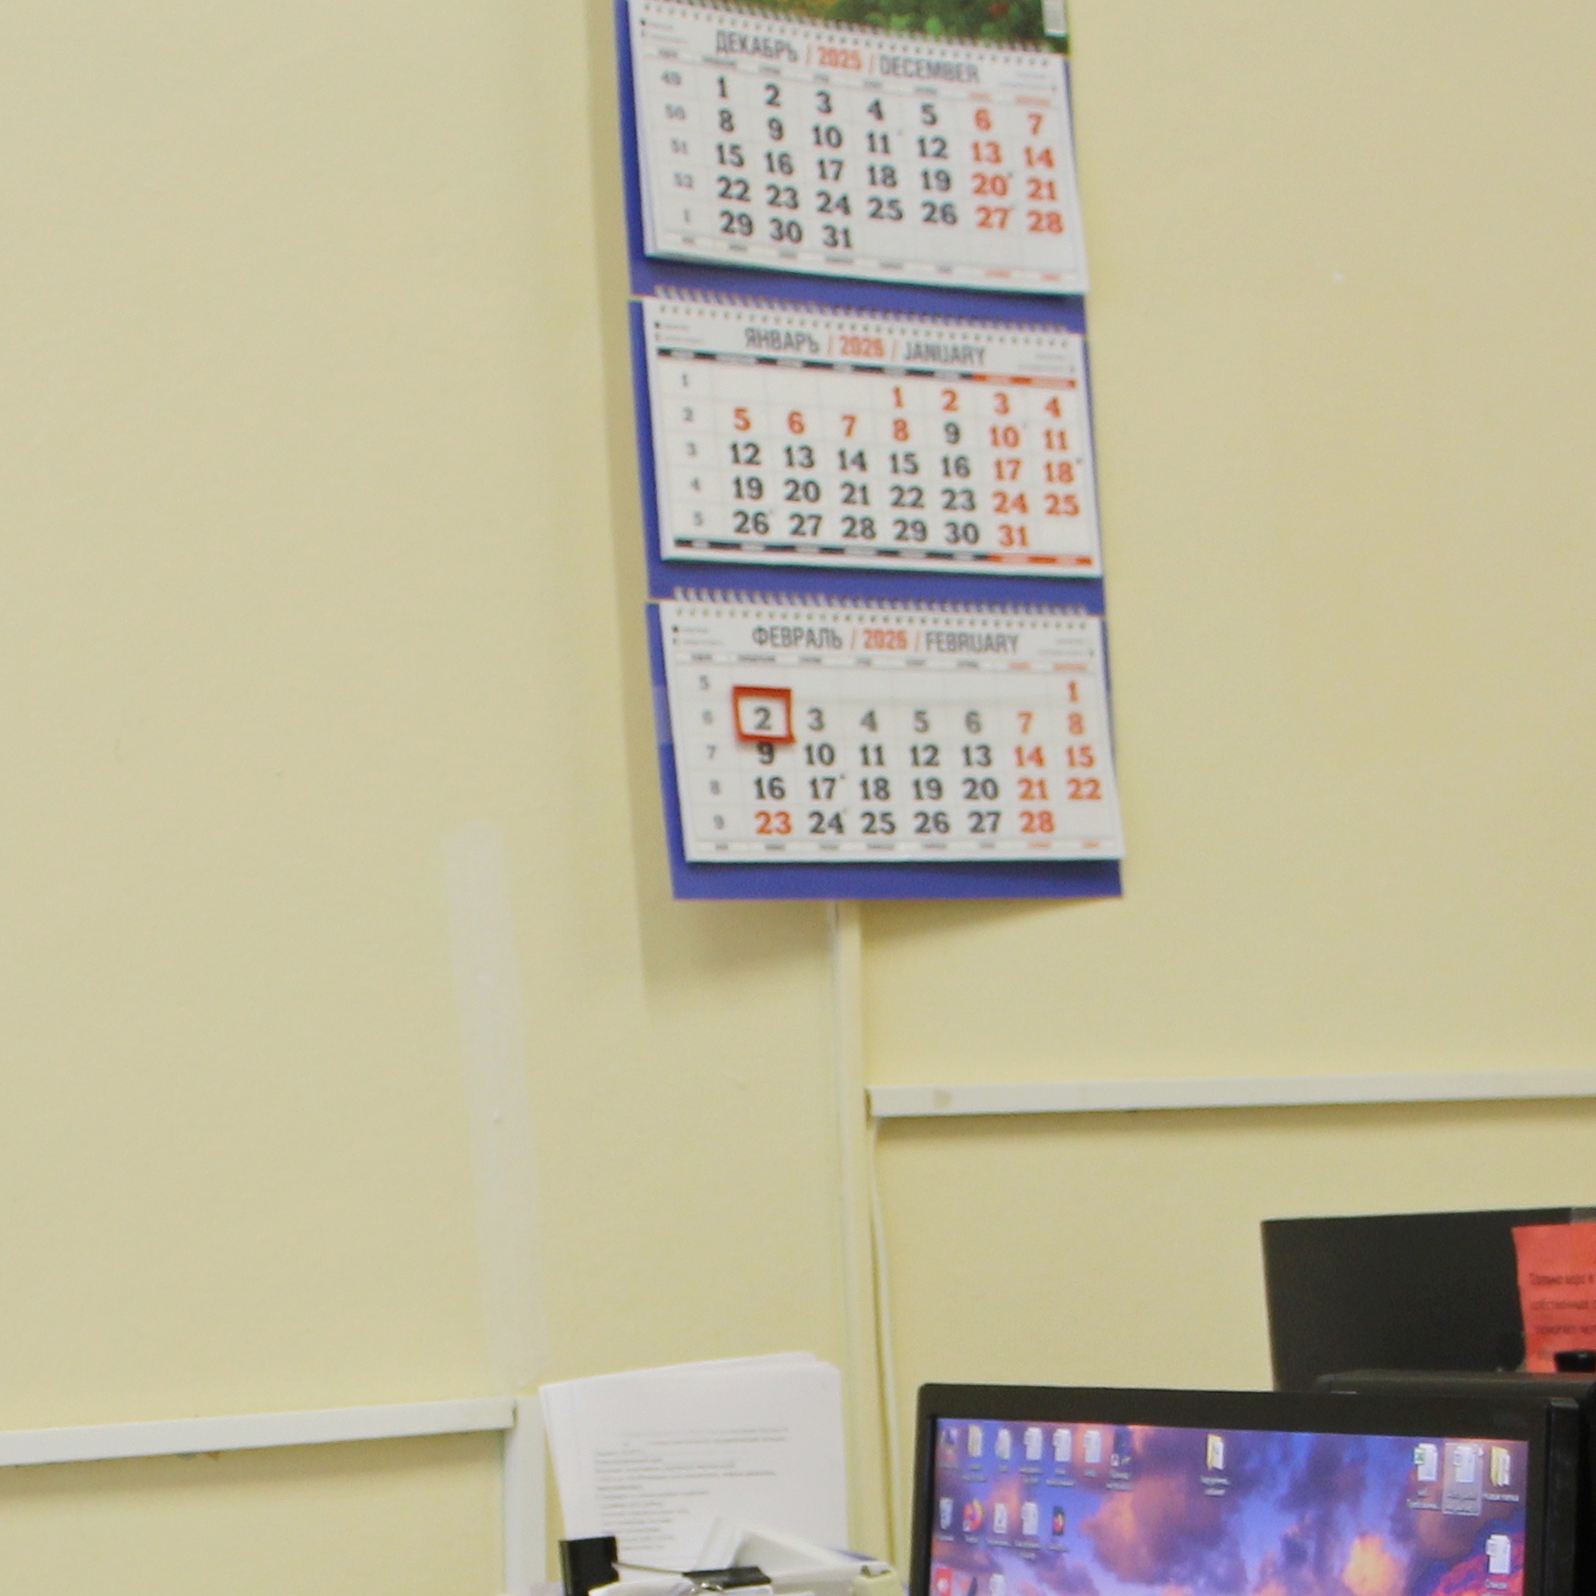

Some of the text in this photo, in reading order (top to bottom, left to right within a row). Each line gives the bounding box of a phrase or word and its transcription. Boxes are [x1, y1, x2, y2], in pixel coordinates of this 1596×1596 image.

[715, 29, 981, 84] ДЕКАБРЬ 2025 DECEMBER
[716, 76, 729, 100] 1
[764, 83, 781, 108] 2
[815, 89, 833, 116] 3
[867, 98, 885, 122] 4
[920, 102, 939, 127] 5
[973, 108, 993, 132] 6
[1027, 112, 1044, 137] 7
[718, 108, 736, 134] 8
[767, 116, 785, 142] 9
[812, 124, 844, 150] 10
[866, 131, 891, 156] 11
[917, 136, 949, 160] 12
[971, 140, 1004, 166] 13
[1024, 146, 1056, 169] 14
[716, 142, 746, 169] 15
[764, 151, 795, 177] 16
[816, 157, 845, 183] 17
[867, 164, 898, 189] 18
[920, 168, 952, 193] 19
[971, 172, 1009, 198] 20
[1026, 176, 1058, 202] 21
[717, 175, 751, 203] 22
[765, 183, 800, 211] 23
[816, 190, 852, 216] 24
[867, 196, 904, 222] 25
[921, 200, 959, 227] 26
[975, 205, 1012, 230] 27
[1026, 209, 1065, 235] 28
[719, 209, 754, 237] 29
[769, 217, 804, 245] 30
[822, 224, 853, 250] 31
[744, 327, 986, 366] ЯНВАРЬ 2026 JANUARY
[891, 385, 905, 409] 1
[941, 388, 959, 413] 2
[994, 391, 1011, 416] 3
[1044, 396, 1062, 419] 4
[733, 406, 752, 432] 5
[787, 410, 806, 435] 6
[841, 413, 858, 438] 7
[892, 417, 911, 443] 8
[943, 421, 962, 446] 9
[989, 425, 1021, 449] 10
[1043, 428, 1069, 452] 11
[729, 441, 762, 466] 12
[784, 444, 816, 470] 13
[837, 449, 868, 473] 14
[889, 451, 920, 476] 15
[941, 454, 972, 479] 16
[993, 458, 1023, 482] 17
[1044, 460, 1075, 485] 18
[733, 476, 764, 501] 19
[784, 478, 822, 504] 20
[840, 481, 870, 507] 21
[889, 484, 925, 510] 22
[941, 487, 977, 513] 23
[992, 490, 1030, 515] 24
[1044, 492, 1081, 517] 25
[733, 509, 770, 536] 26
[789, 512, 823, 538] 27
[841, 515, 877, 541] 28
[893, 518, 929, 543] 29
[945, 521, 981, 546] 30
[998, 523, 1030, 548] 31
[752, 626, 1019, 654] ФЕВРАЛЬ 2026 FEBRUARY
[1067, 679, 1080, 704] 1
[753, 705, 772, 732] 2
[807, 706, 826, 733] 3
[859, 709, 878, 733] 4
[913, 708, 931, 734] 5
[964, 709, 983, 735] 6
[1017, 710, 1034, 735] 7
[1067, 711, 1086, 736] 8
[757, 742, 776, 766] 9
[804, 742, 836, 767] 10
[859, 743, 885, 767] 11
[909, 743, 941, 768] 12
[962, 743, 993, 768] 13
[1014, 745, 1046, 768] 14
[1065, 744, 1096, 769] 15
[754, 776, 786, 801] 16
[809, 776, 837, 801] 17
[859, 776, 891, 802] 18
[912, 777, 944, 801] 19
[962, 776, 1000, 801] 20
[1017, 777, 1050, 801] 21
[1066, 776, 1103, 801] 22
[754, 810, 793, 836] 23
[808, 810, 845, 835] 24
[860, 810, 897, 836] 25
[913, 810, 951, 835] 26
[968, 810, 1002, 834] 27
[1019, 809, 1056, 834] 28
